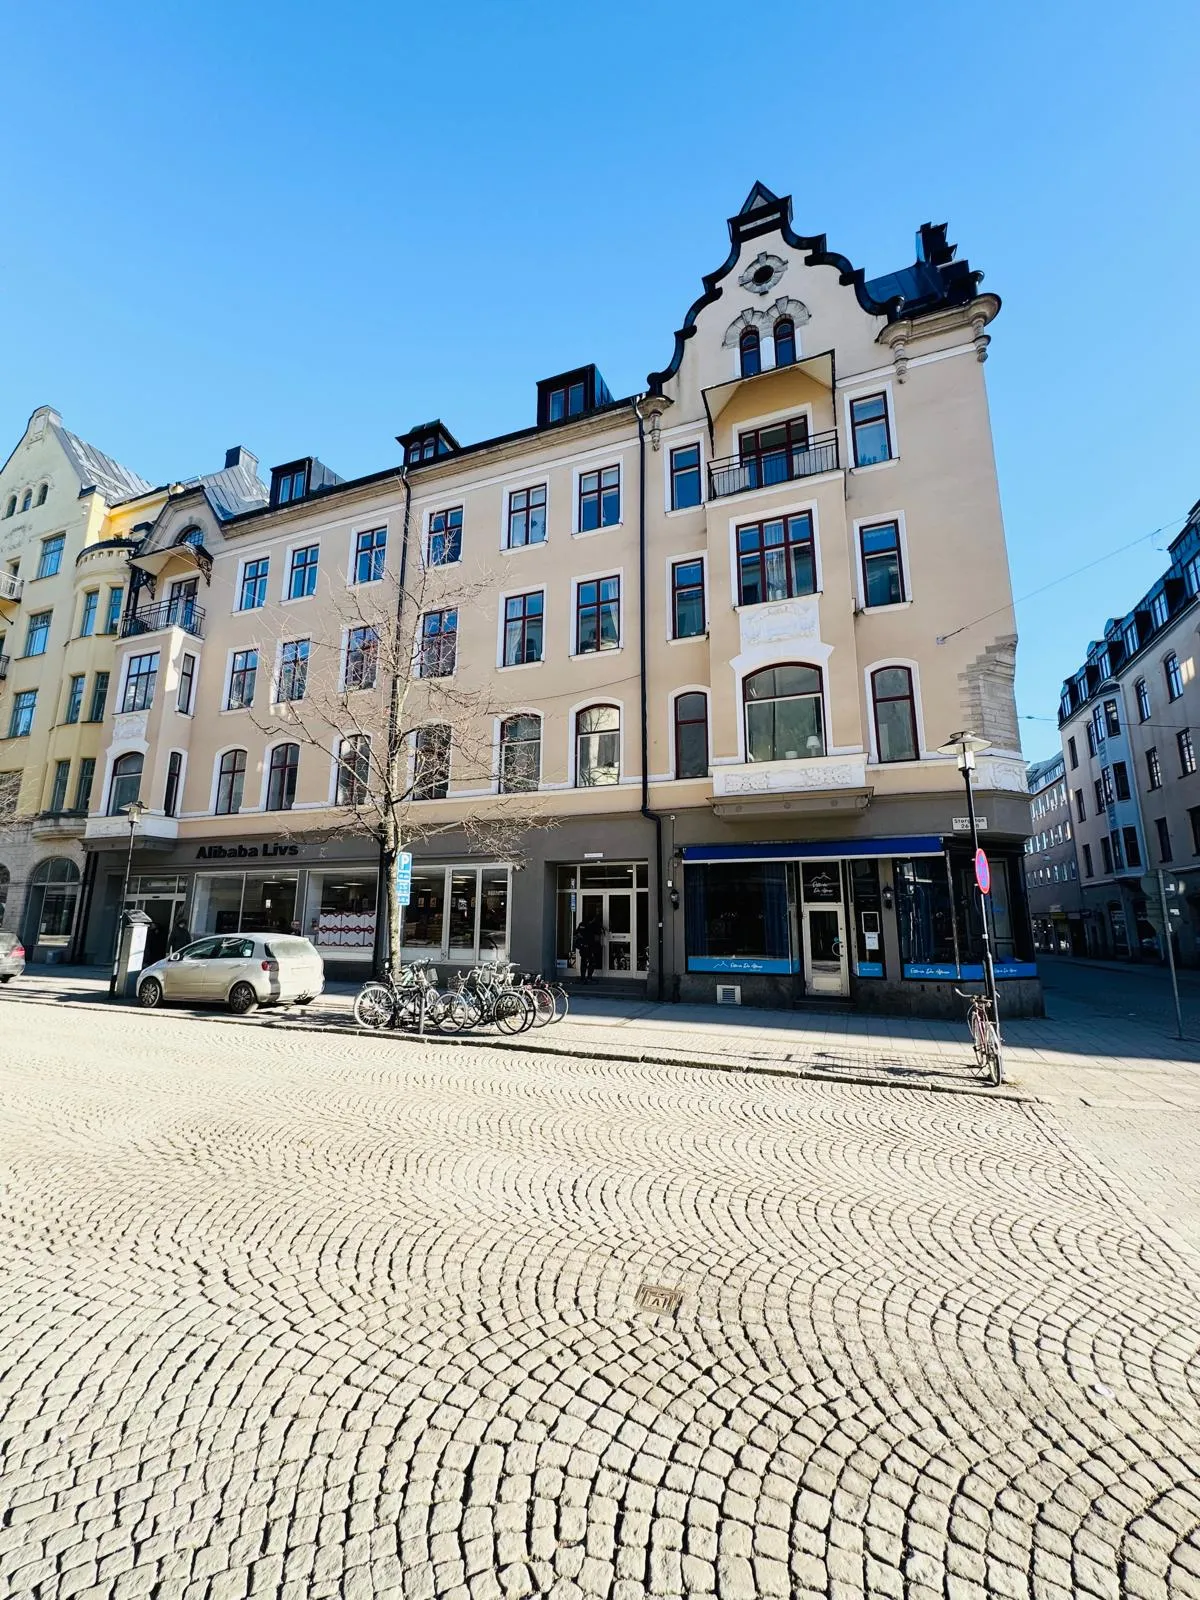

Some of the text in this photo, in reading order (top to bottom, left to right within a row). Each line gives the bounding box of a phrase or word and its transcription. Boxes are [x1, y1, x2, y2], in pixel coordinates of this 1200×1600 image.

[196, 843, 299, 859] Alibaba Livs
[400, 854, 410, 870] P
